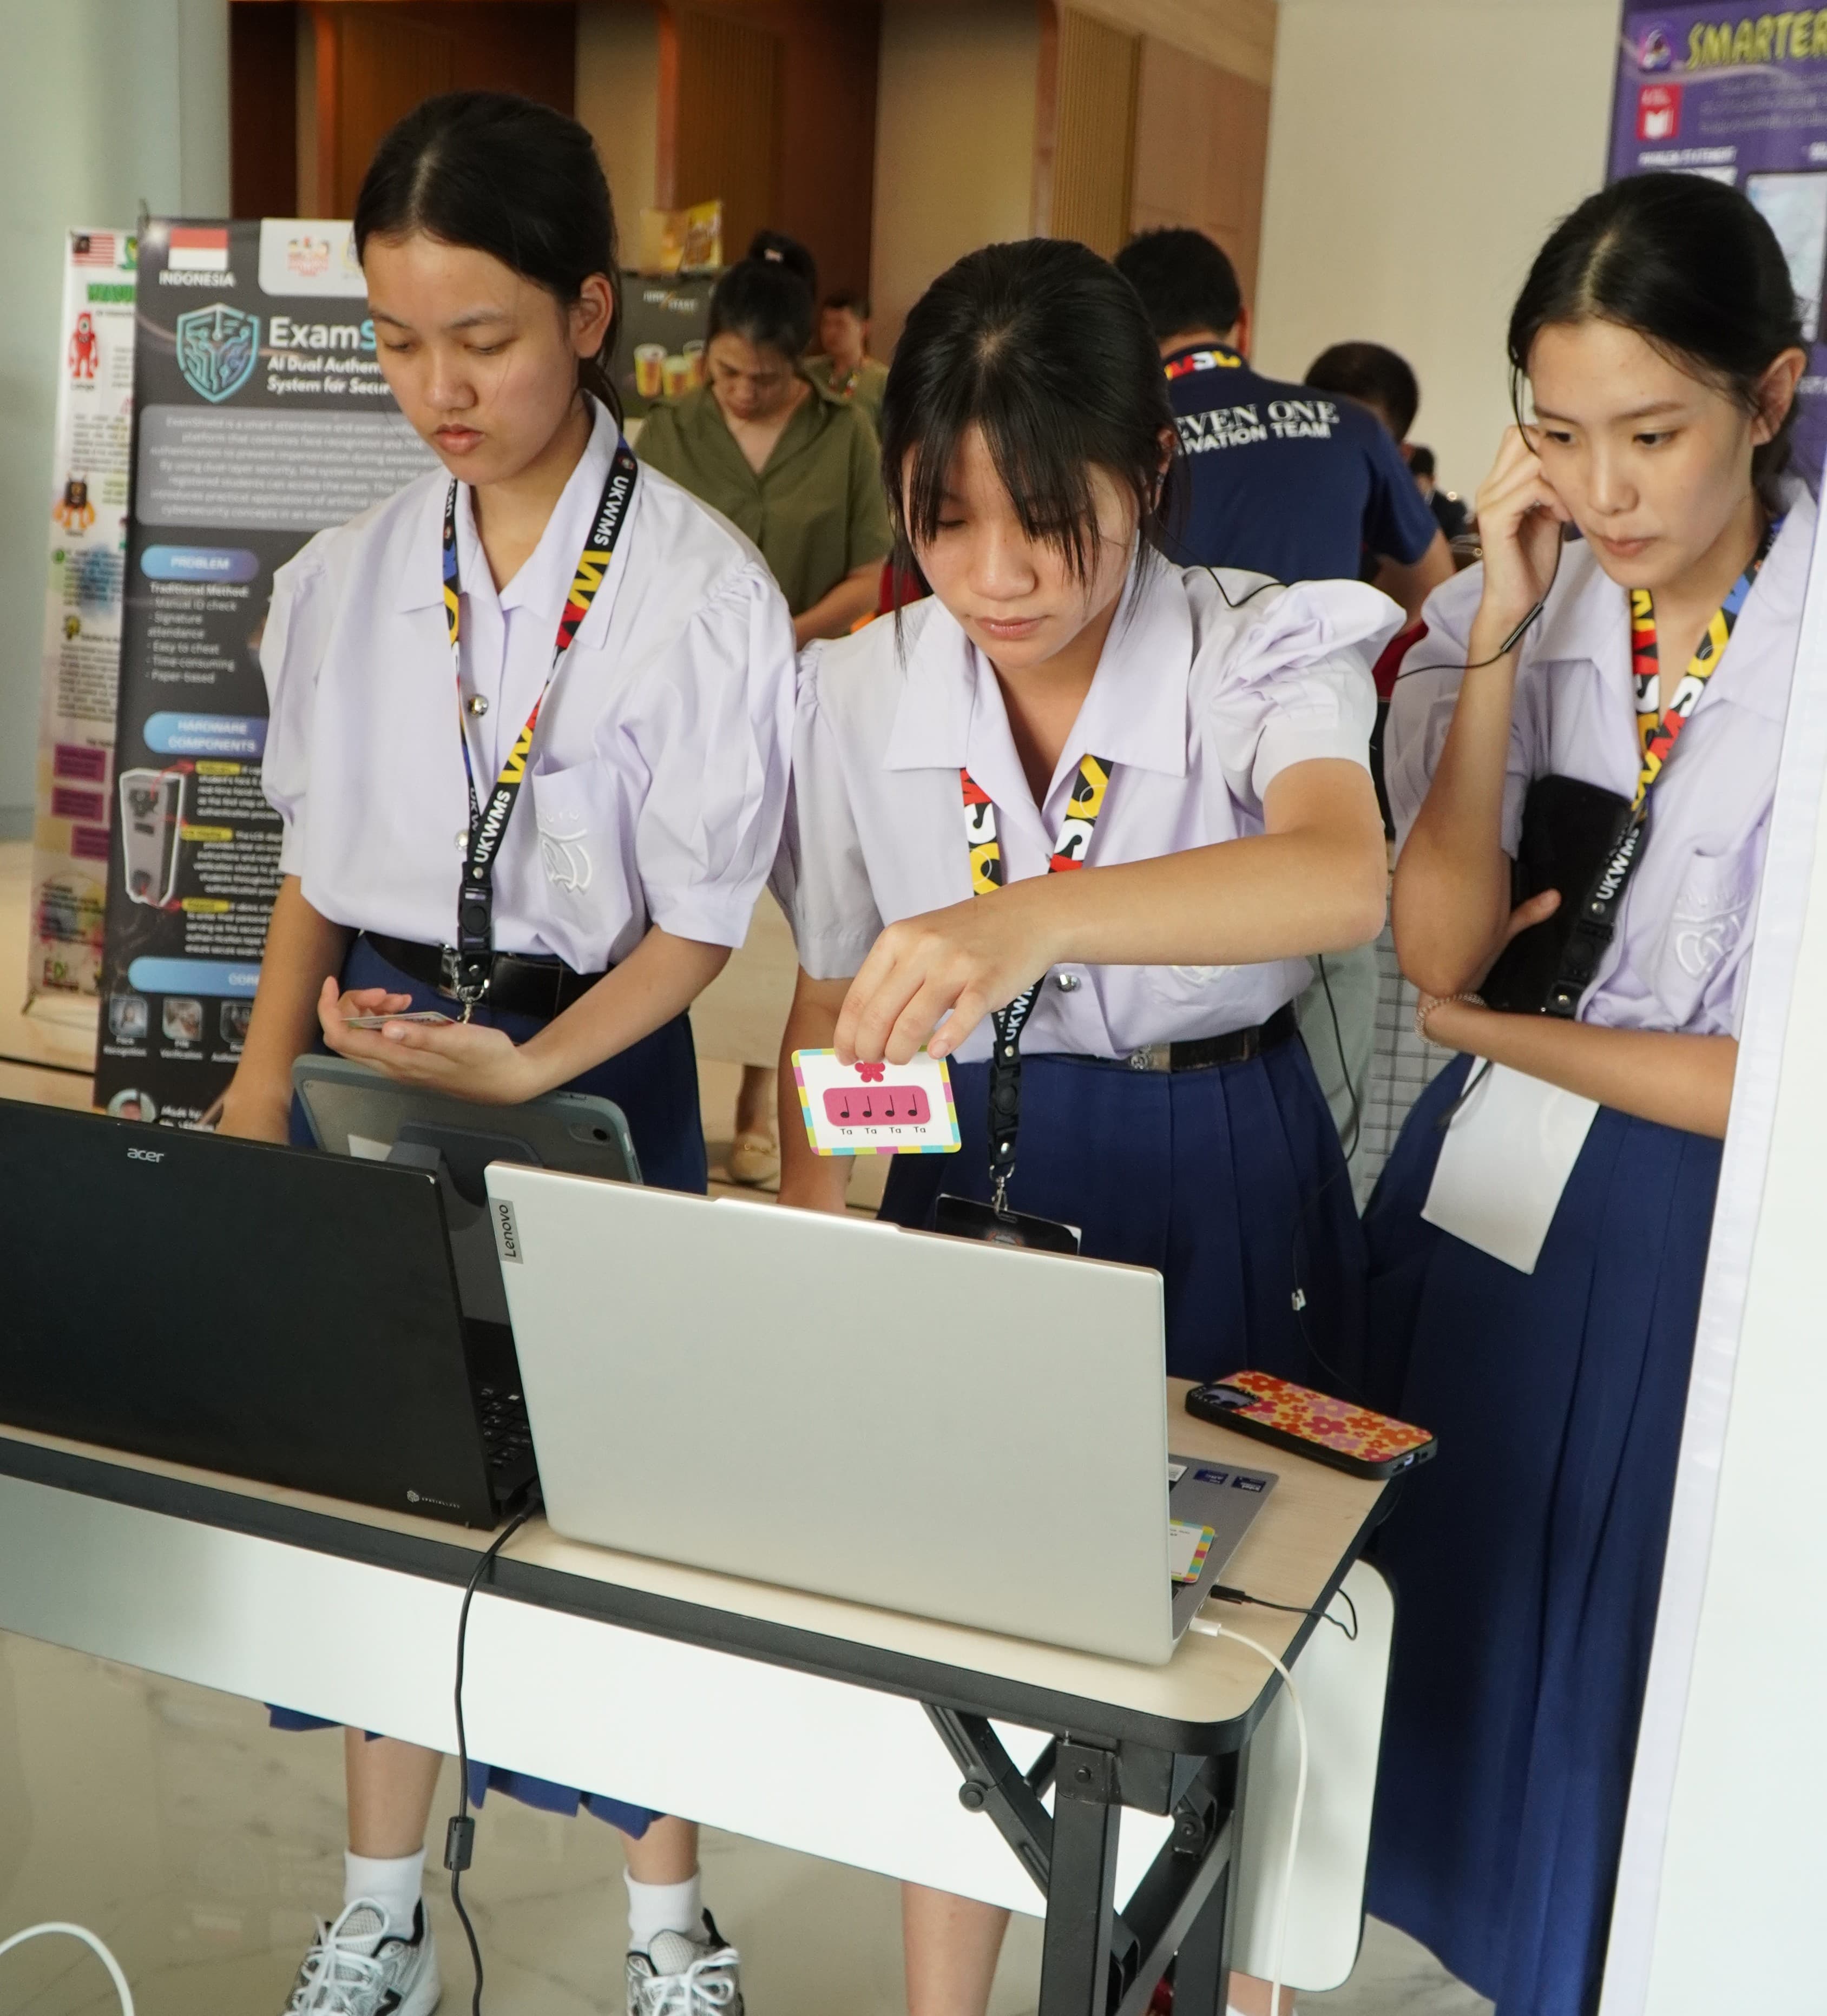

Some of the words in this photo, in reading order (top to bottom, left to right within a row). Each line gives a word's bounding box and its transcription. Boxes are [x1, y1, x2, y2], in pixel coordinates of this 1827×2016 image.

[159, 271, 236, 287] INDONESIA
[270, 317, 377, 351] ExamS
[268, 357, 284, 372] AI
[287, 358, 321, 373] Dual
[324, 357, 381, 374] Authen
[267, 379, 321, 395] System
[324, 377, 347, 393] for
[349, 379, 391, 395] Secur
[1267, 400, 1340, 424] ONE
[1270, 421, 1332, 439] TEAM
[594, 475, 630, 546] UKWMS
[170, 556, 231, 570] PROBLEM
[150, 581, 206, 595] Traditional
[178, 720, 247, 735] HARDWARE
[168, 735, 257, 753] COMPONENTS
[474, 790, 511, 864] UKWMS
[1004, 986, 1035, 1042] UKW
[864, 1127, 878, 1135] Ta
[889, 1126, 902, 1135] Ta
[913, 1125, 926, 1134] Ta
[127, 1148, 165, 1163] acer
[499, 1204, 517, 1258] Lenovo
